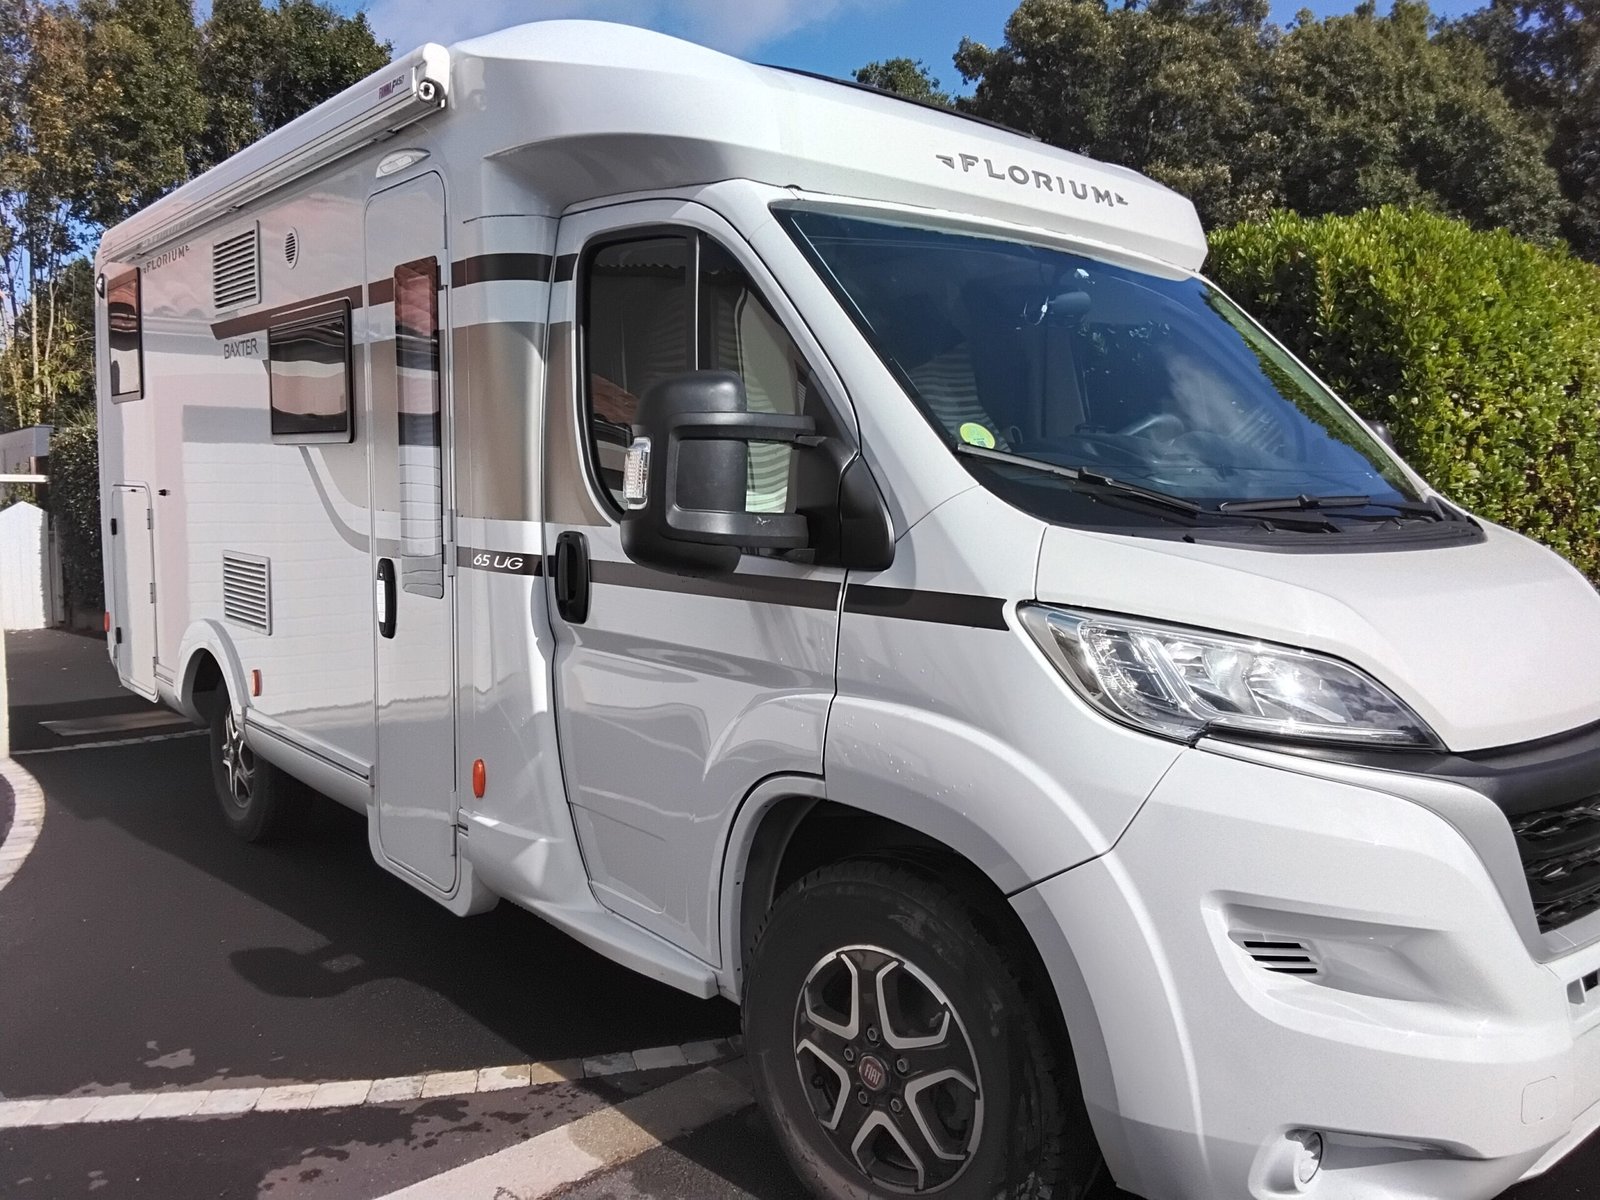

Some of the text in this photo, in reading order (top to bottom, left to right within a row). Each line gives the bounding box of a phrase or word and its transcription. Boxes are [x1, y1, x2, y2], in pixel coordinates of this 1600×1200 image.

[959, 153, 1114, 207] FLORIUM
[146, 246, 186, 273] FLORIUM
[223, 337, 259, 360] BAXTER
[473, 553, 524, 570] 65 UG
[864, 1063, 881, 1085] FIAT
